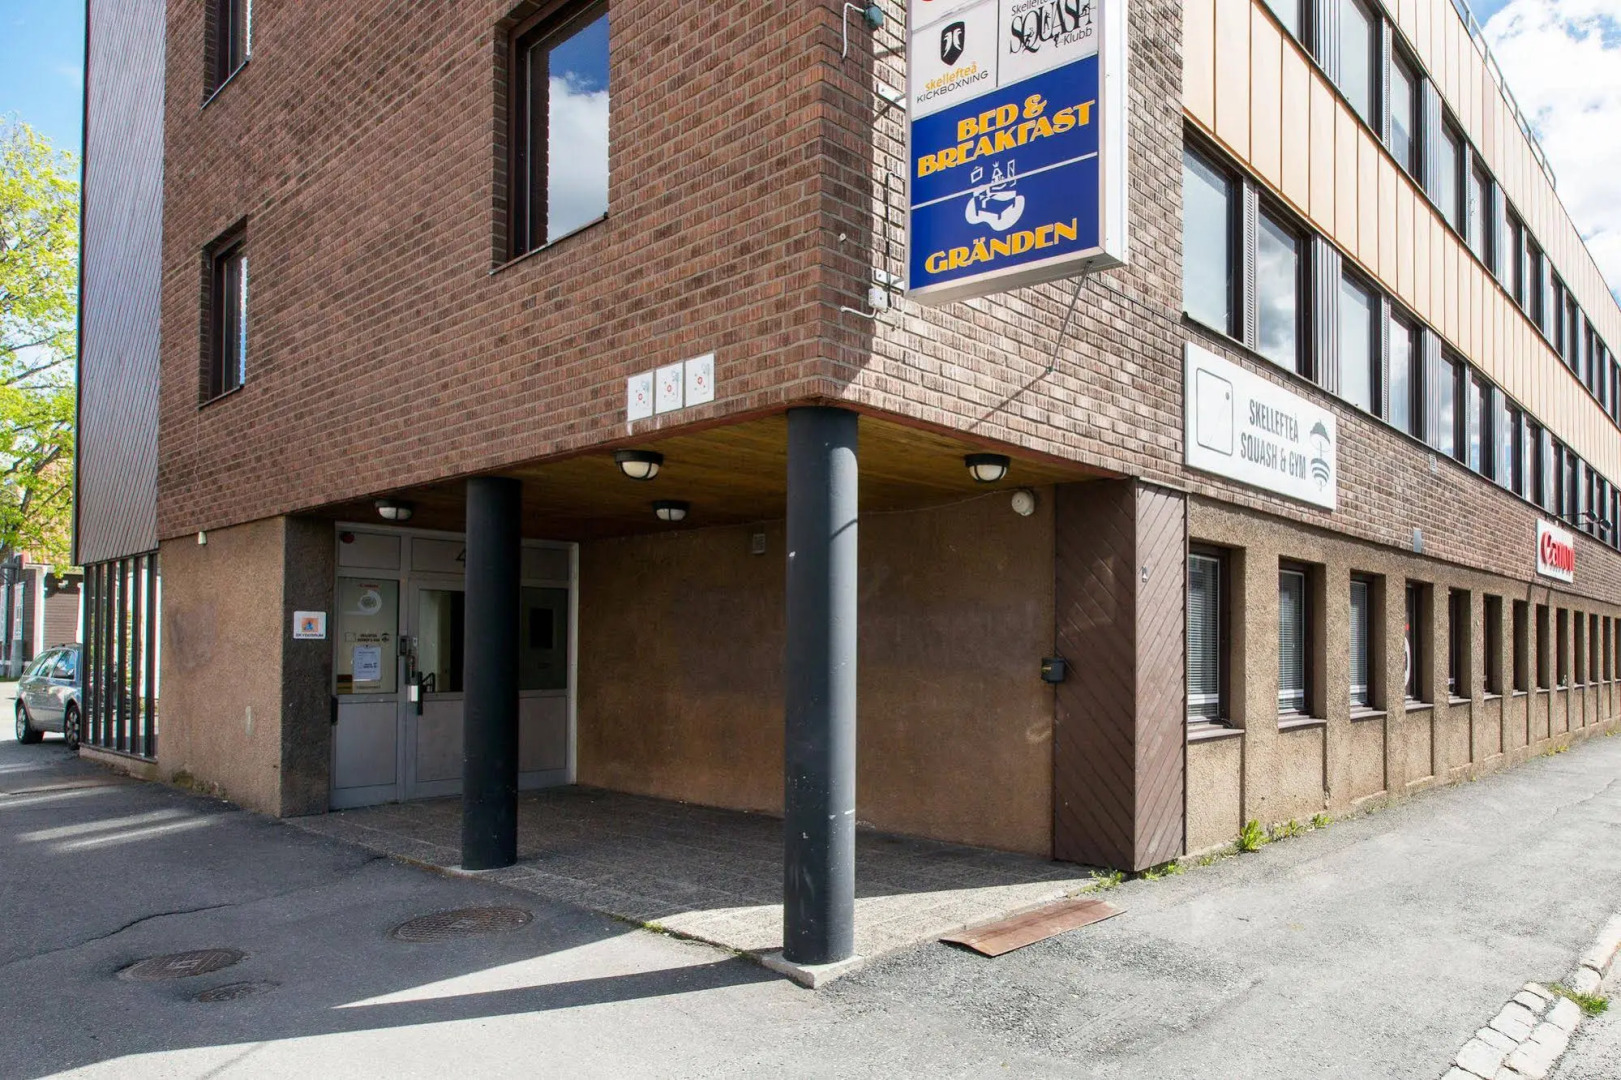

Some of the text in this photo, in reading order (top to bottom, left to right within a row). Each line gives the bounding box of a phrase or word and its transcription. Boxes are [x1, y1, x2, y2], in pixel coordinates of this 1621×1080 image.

[1010, 0, 1094, 54] SQUASH
[1063, 26, 1093, 46] Klubb
[916, 70, 989, 104] KICKBOXNING
[925, 61, 977, 91] skellefteå
[917, 100, 1095, 178] BREAKFAST
[957, 94, 1047, 142] BED &
[924, 217, 1077, 274] GRÄNDEN
[1249, 399, 1299, 444] SKELLEFTEÅ
[1240, 432, 1307, 481] SQUASH & GYM
